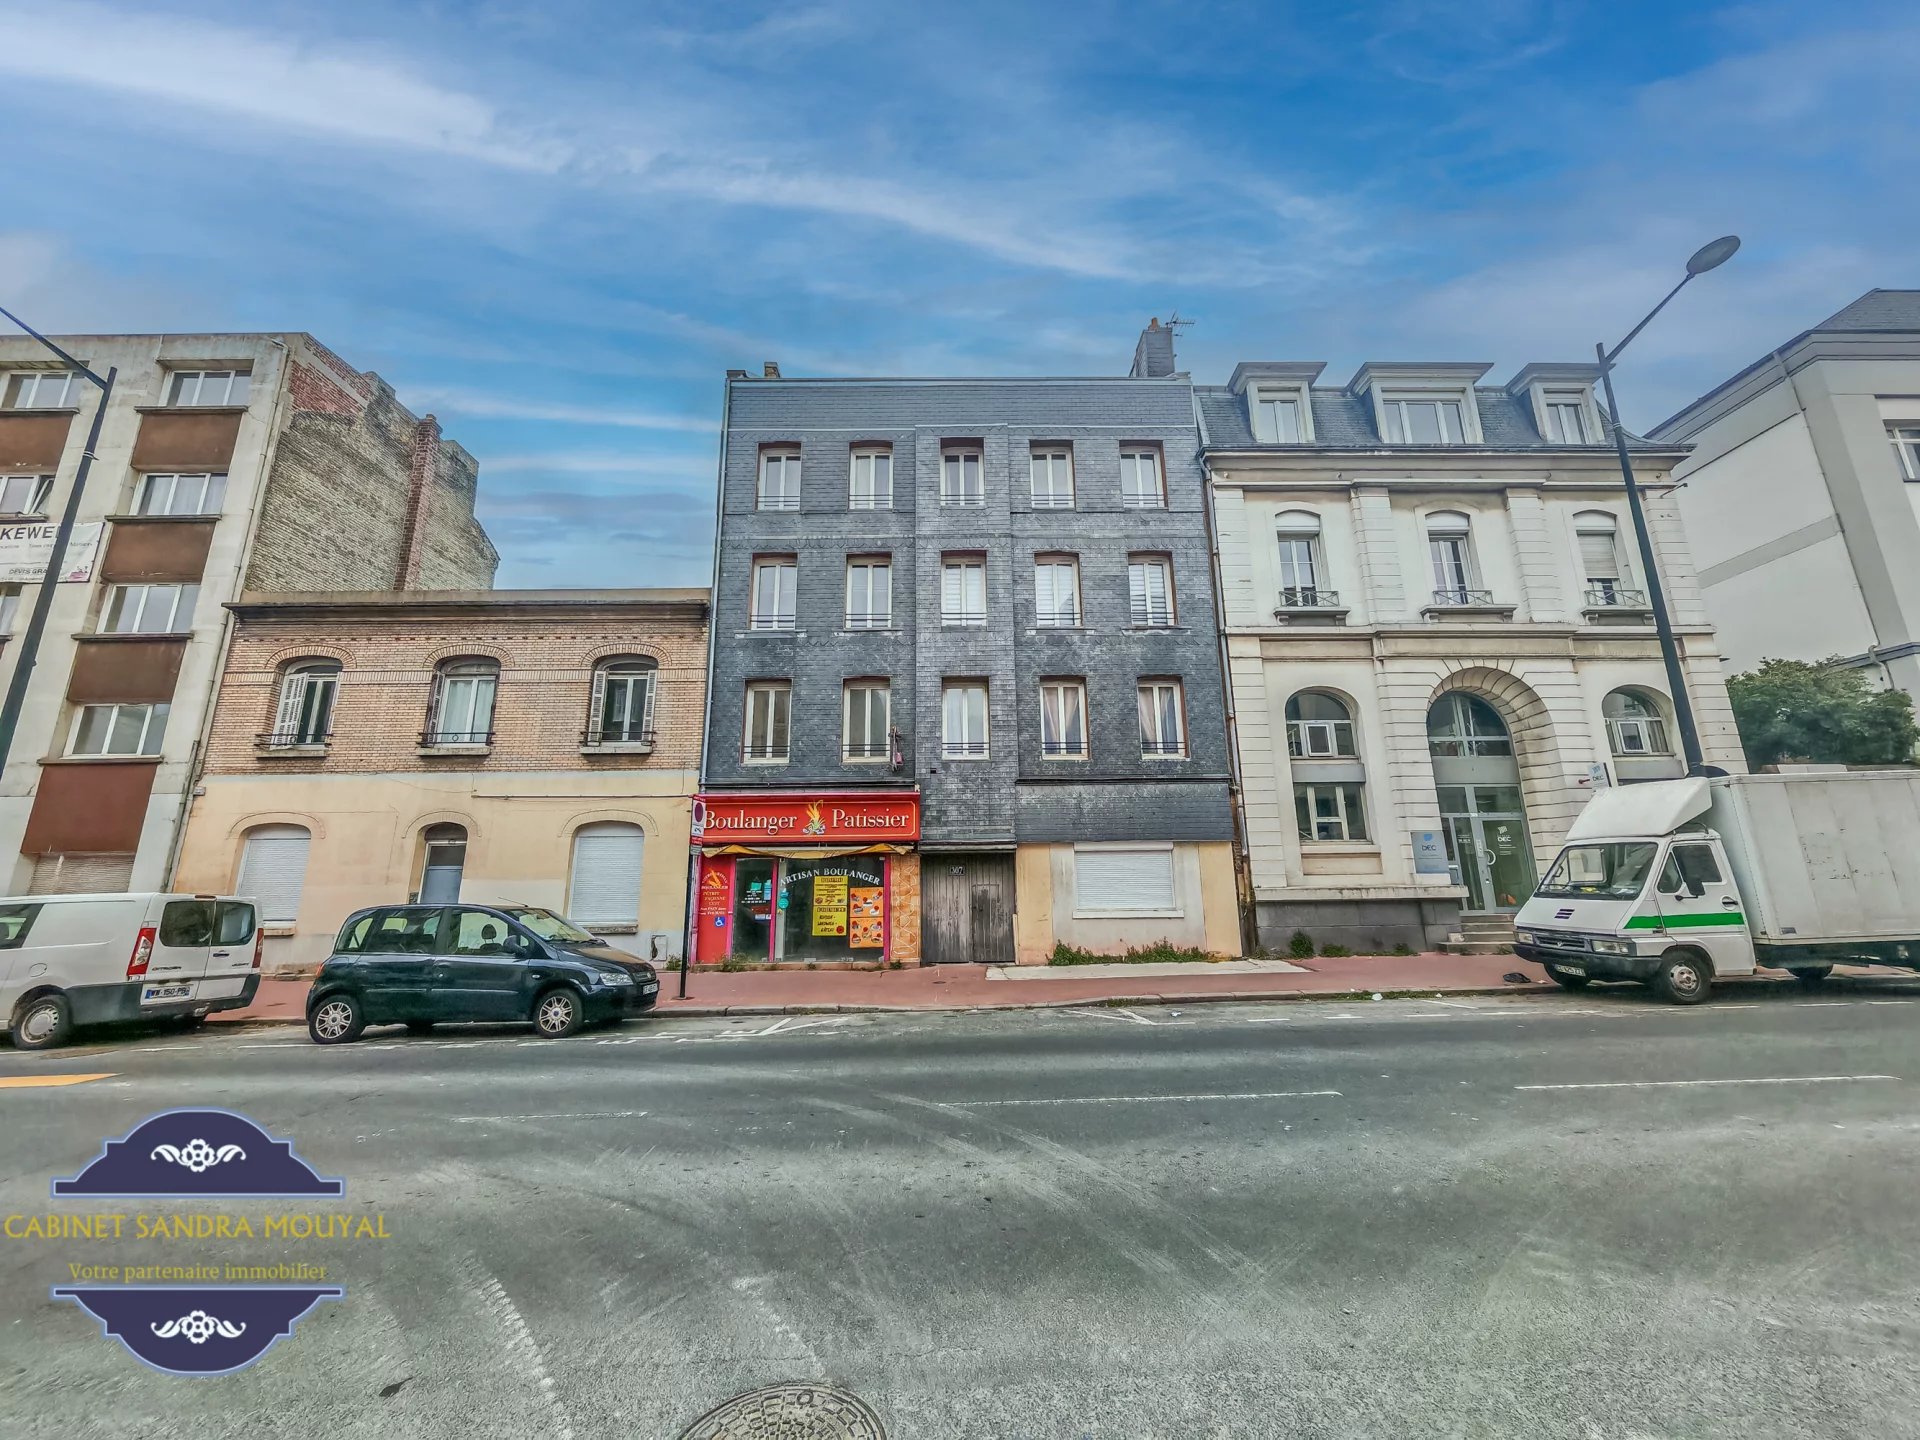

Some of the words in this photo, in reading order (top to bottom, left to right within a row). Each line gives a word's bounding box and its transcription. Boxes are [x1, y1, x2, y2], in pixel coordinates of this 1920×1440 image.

[0, 526, 60, 540] KEWE
[704, 810, 798, 835] Boulanger
[832, 808, 909, 829] Patissier
[780, 868, 820, 886] ARTISAN
[824, 867, 880, 885] BOULANGER
